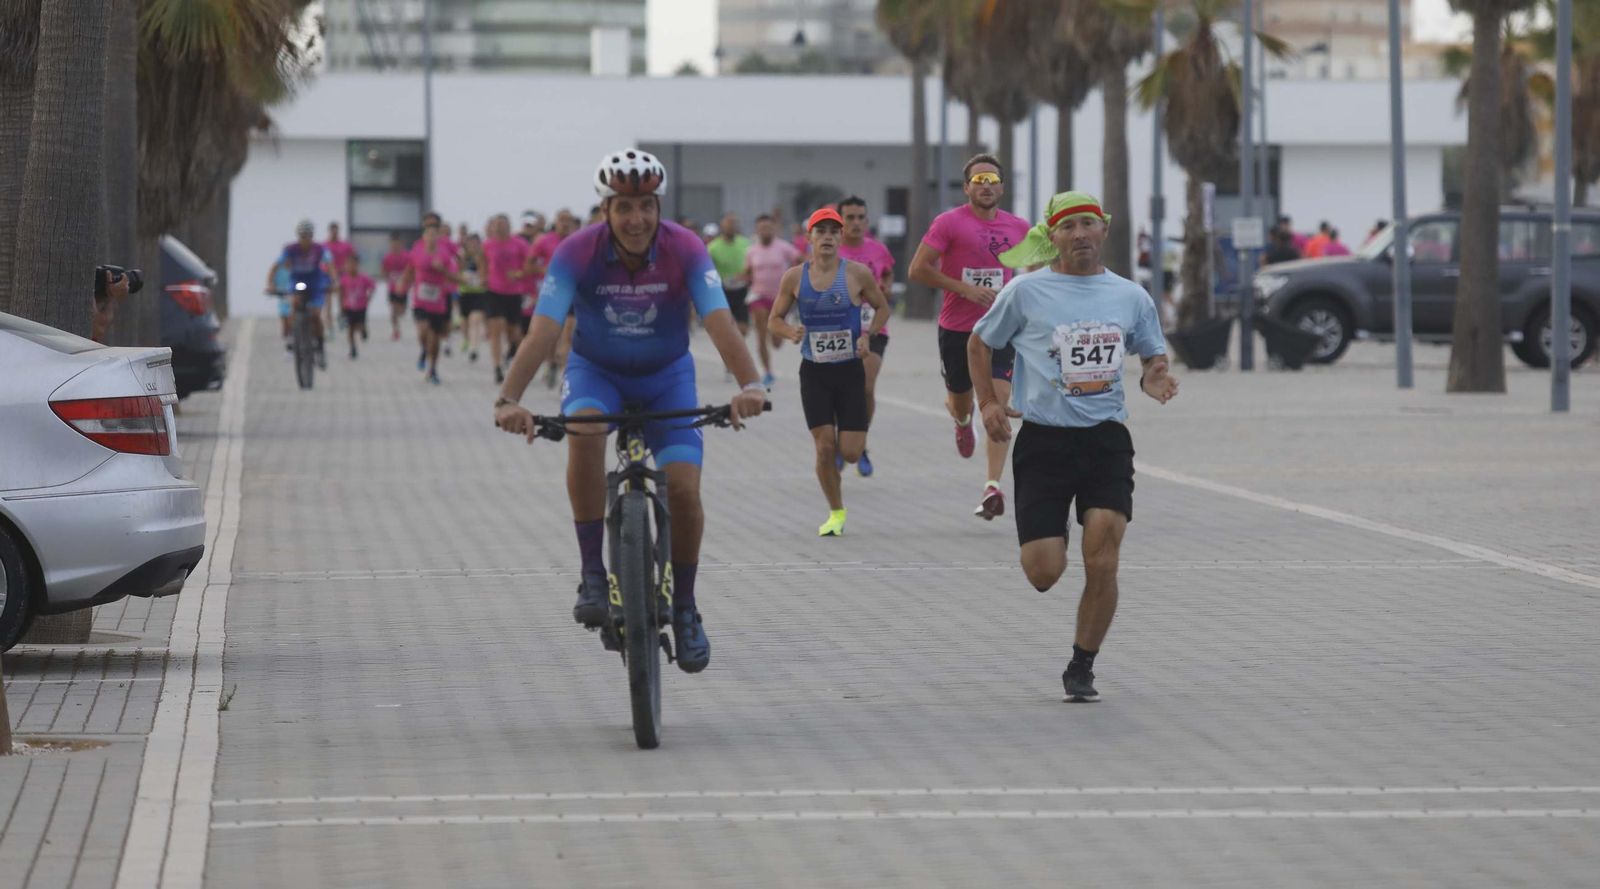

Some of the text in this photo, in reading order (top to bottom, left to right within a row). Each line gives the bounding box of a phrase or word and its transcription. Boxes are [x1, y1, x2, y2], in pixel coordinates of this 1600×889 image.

[973, 277, 993, 288] 76
[816, 339, 847, 353] 542
[1071, 345, 1116, 366] 547
